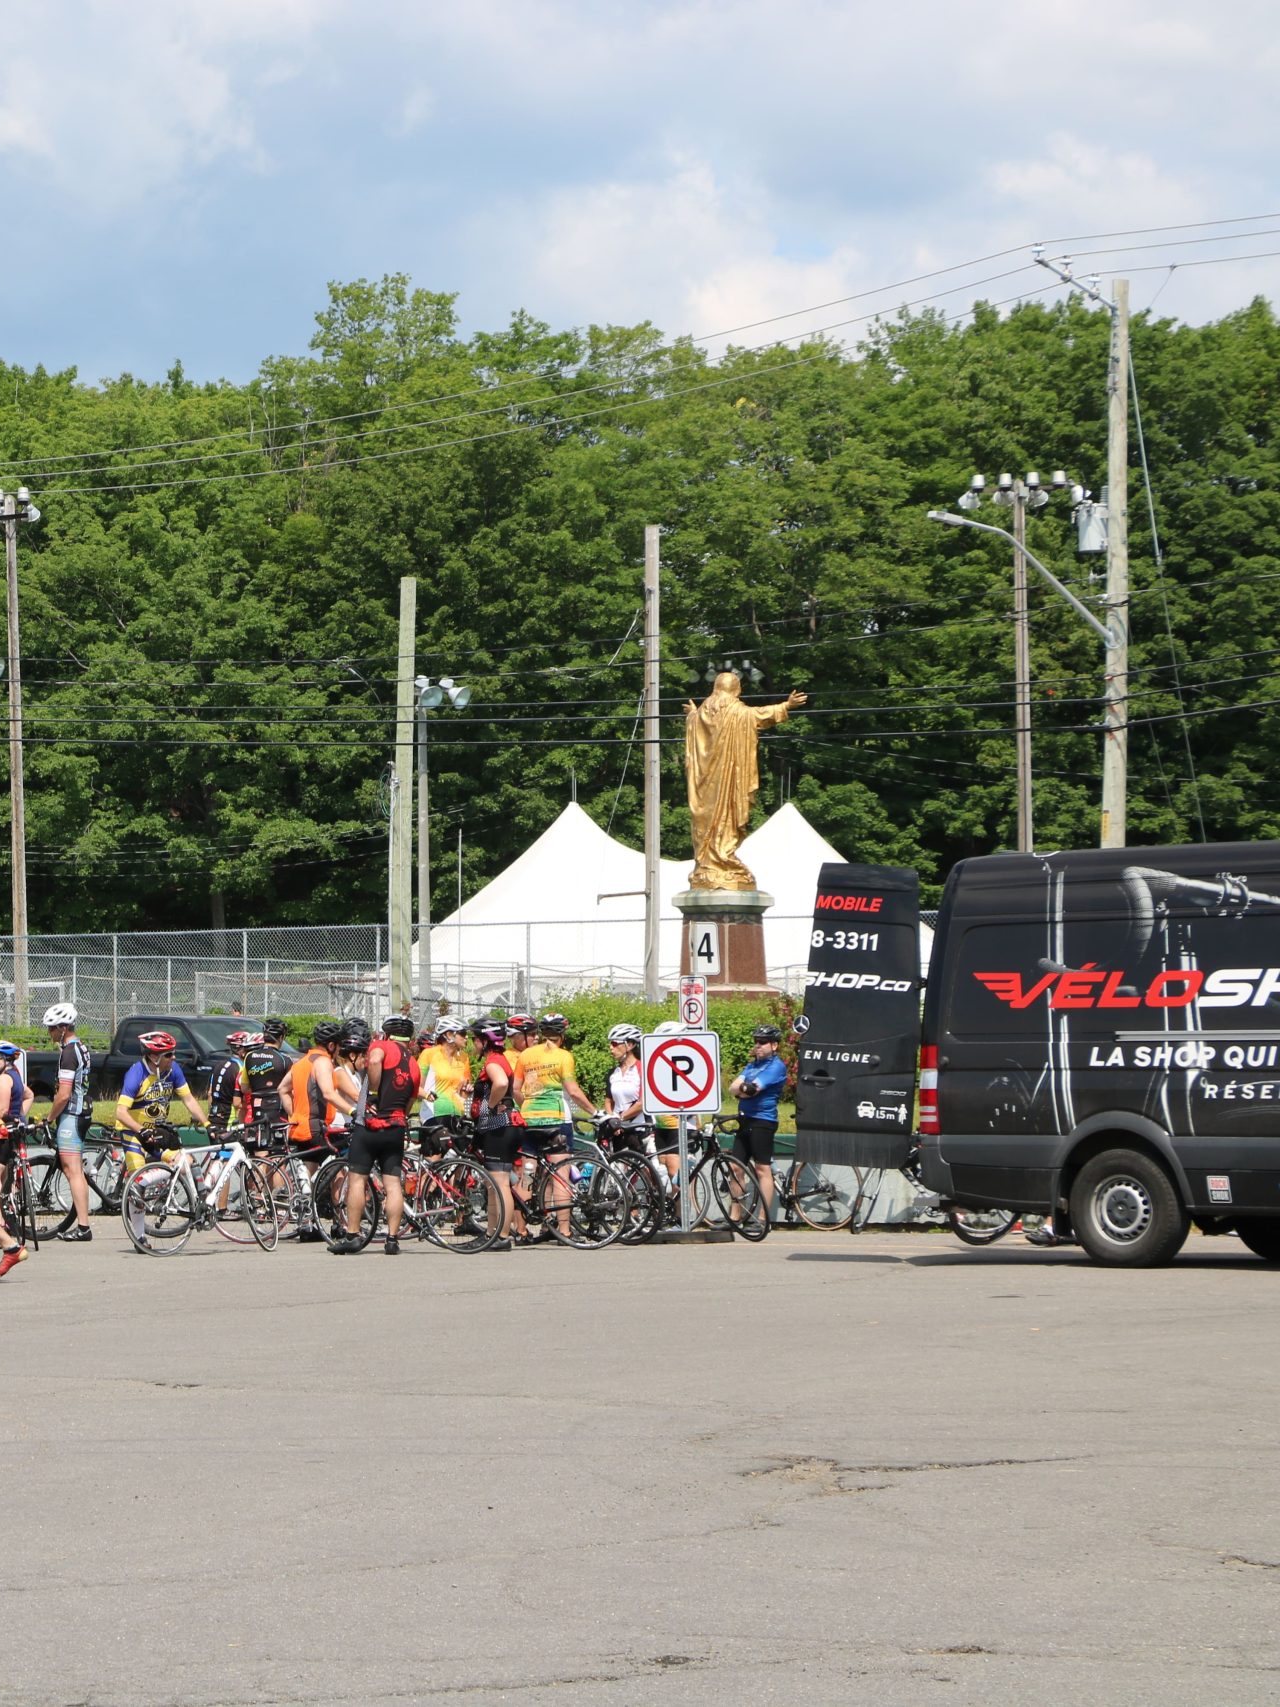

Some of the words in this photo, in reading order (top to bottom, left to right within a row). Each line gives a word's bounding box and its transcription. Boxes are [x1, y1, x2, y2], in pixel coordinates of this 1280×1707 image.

[816, 895, 883, 912] MOBILE
[697, 932, 714, 964] 4
[811, 930, 879, 952] 8-3311
[804, 1050, 822, 1060] EN
[827, 1052, 871, 1064] LIGNE
[1089, 1047, 1125, 1067] LA
[1134, 1046, 1217, 1068] SHOP
[1223, 1045, 1278, 1069] QUI
[1203, 1080, 1280, 1099] RÉSE
